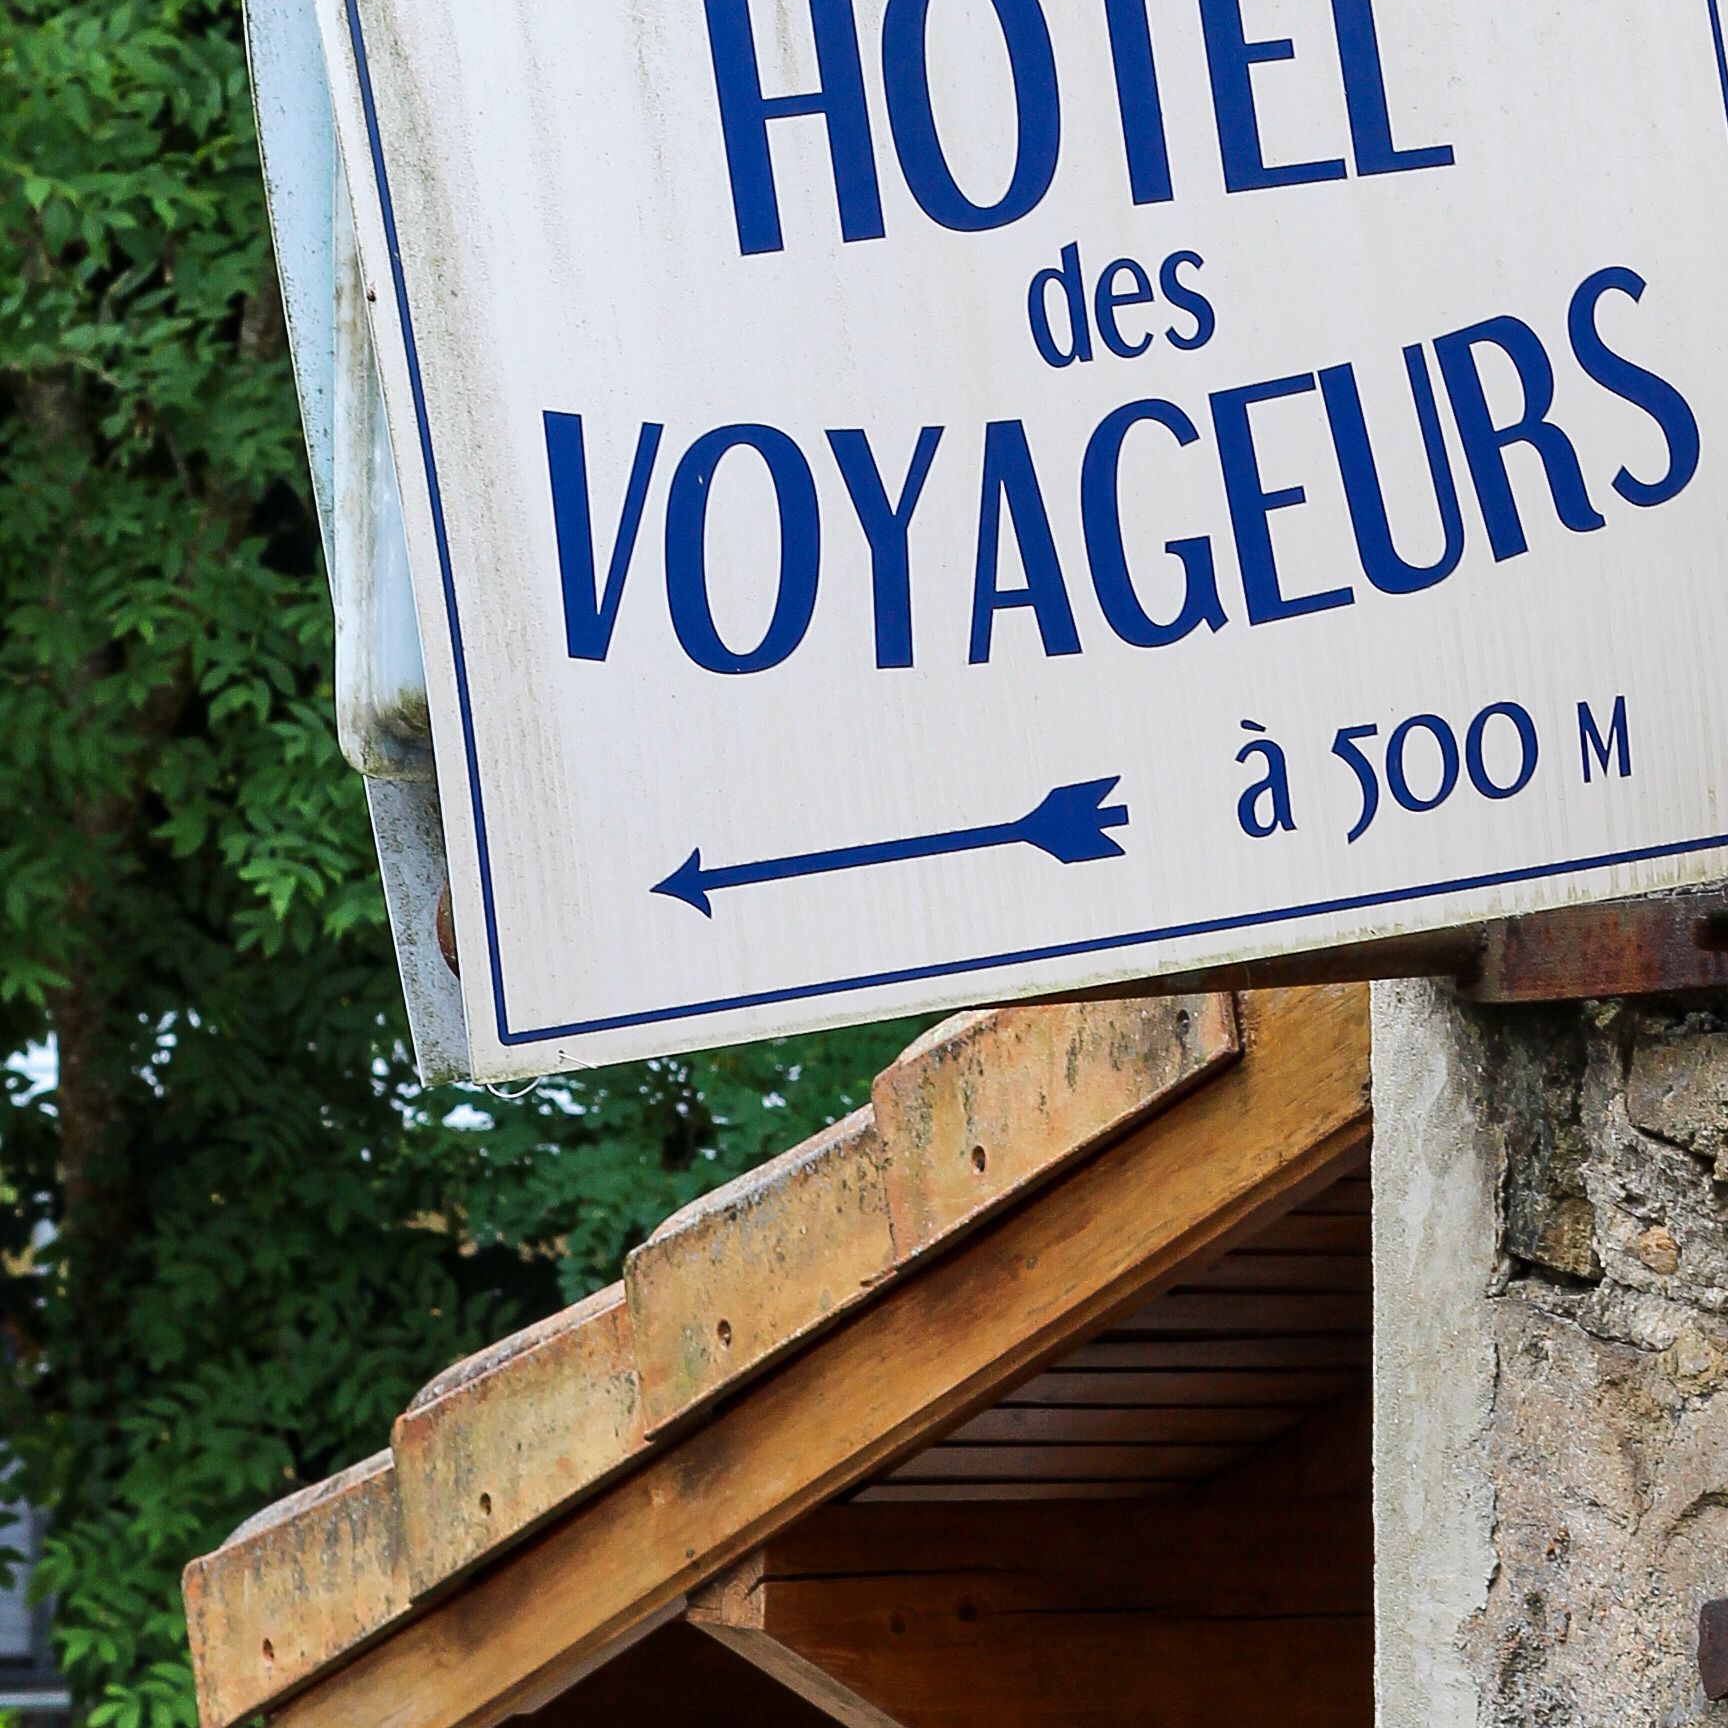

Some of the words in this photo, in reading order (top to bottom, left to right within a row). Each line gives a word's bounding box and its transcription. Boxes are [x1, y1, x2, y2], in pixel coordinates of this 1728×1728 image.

[1027, 241, 1216, 369] des
[542, 266, 1701, 674] VOYAGEURS
[1236, 719, 1295, 840] à
[1332, 702, 1539, 844] 500
[1576, 696, 1632, 783] M
